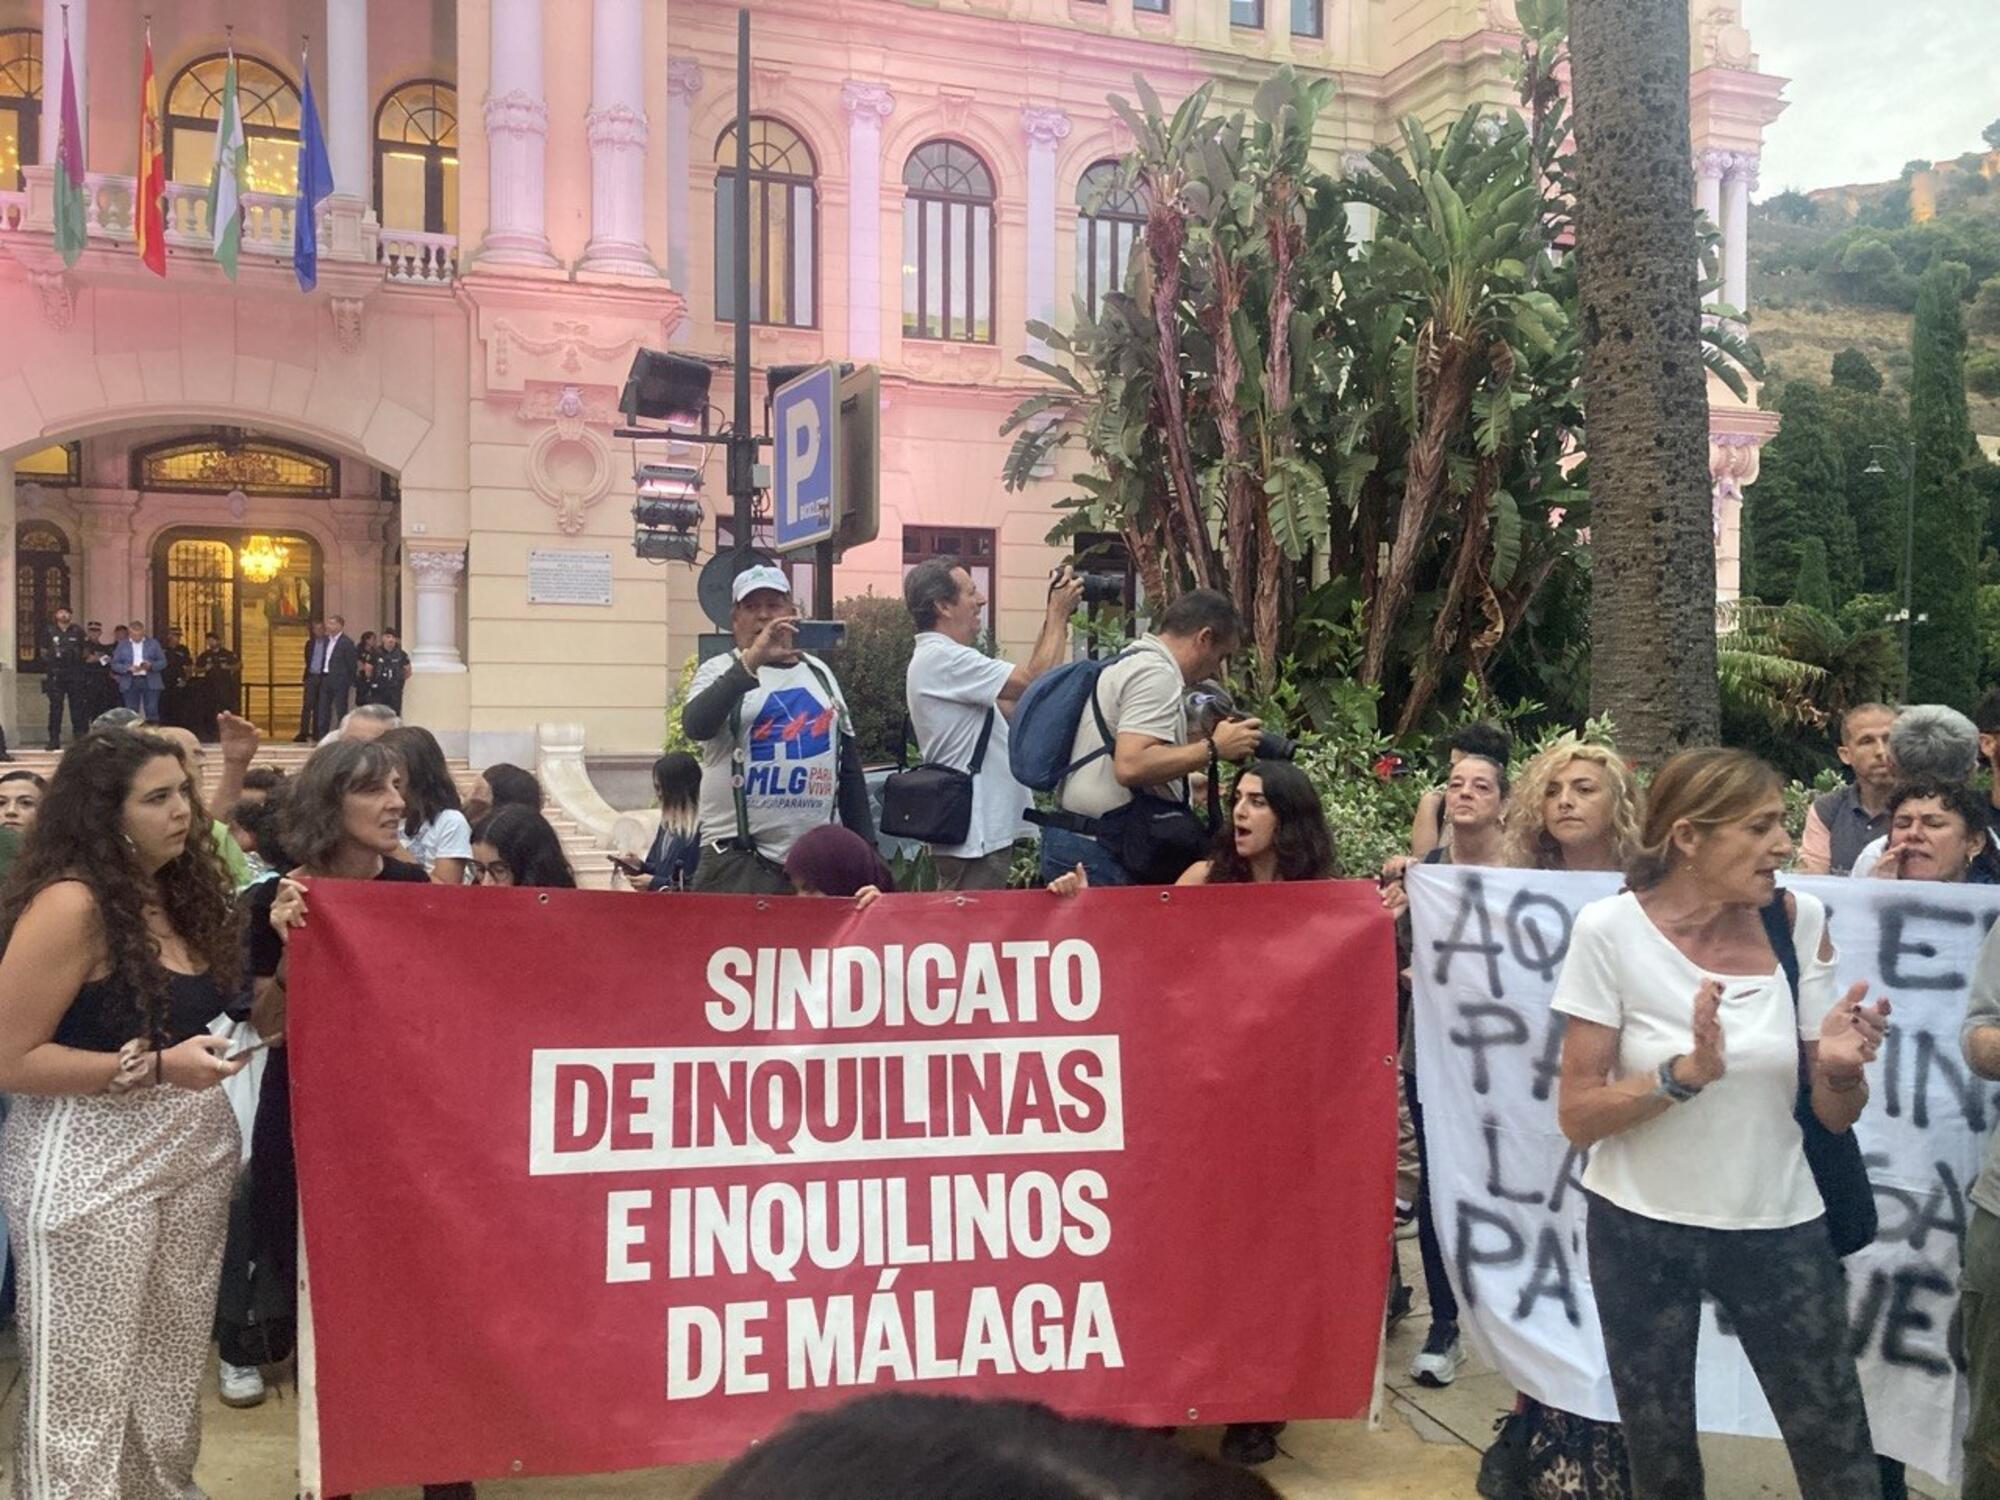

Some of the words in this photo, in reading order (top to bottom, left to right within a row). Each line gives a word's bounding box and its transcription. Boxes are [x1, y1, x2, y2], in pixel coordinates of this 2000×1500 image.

[786, 398, 821, 525] P
[746, 766, 808, 795] MLG
[704, 938, 1102, 1032] SINDICATO
[1432, 872, 1572, 999] AQ
[553, 1063, 655, 1154] DE
[671, 1049, 1107, 1155] INQUILINAS
[605, 1189, 652, 1283] E
[669, 1169, 1112, 1283] INQUILINOS
[667, 1301, 769, 1401] DE
[786, 1268, 1125, 1391] MÁLAGA
